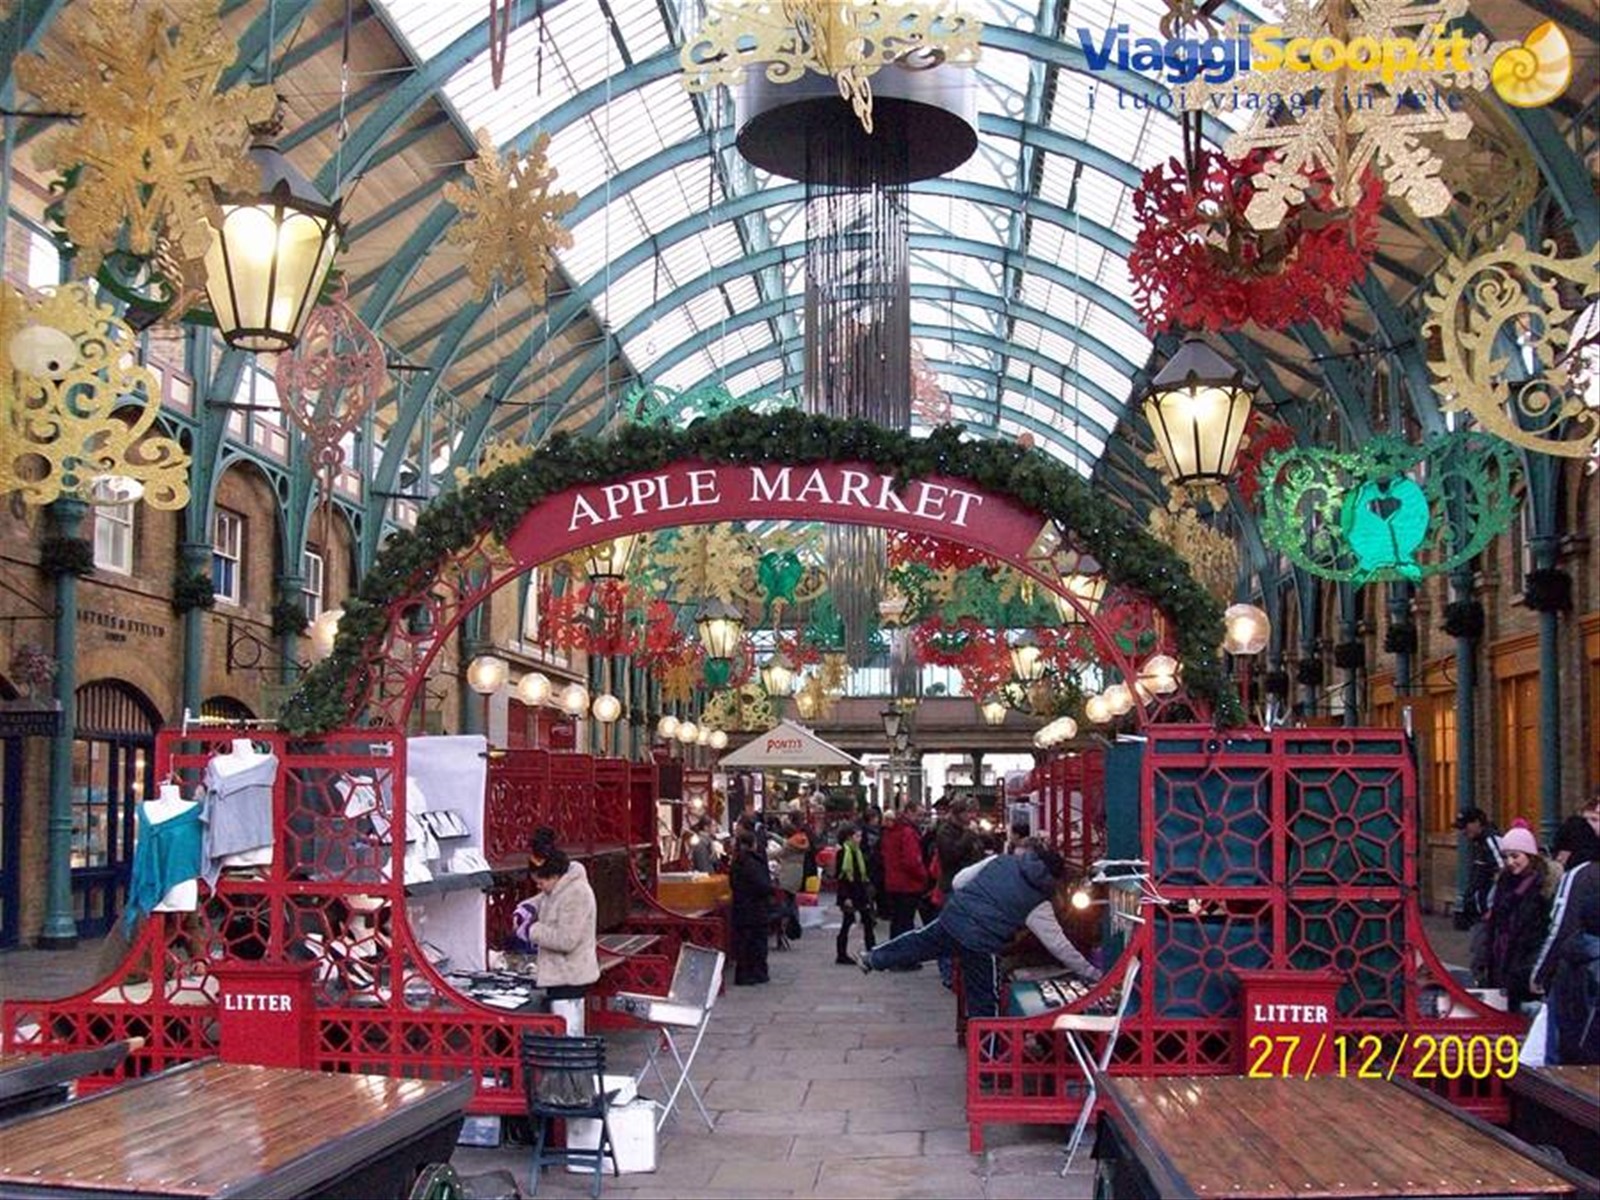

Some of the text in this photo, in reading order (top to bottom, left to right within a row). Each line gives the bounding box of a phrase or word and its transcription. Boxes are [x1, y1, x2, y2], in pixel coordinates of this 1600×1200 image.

[567, 467, 983, 531] APPLE MARKET
[224, 994, 292, 1012] LITTER
[1254, 1004, 1328, 1023] LITTER
